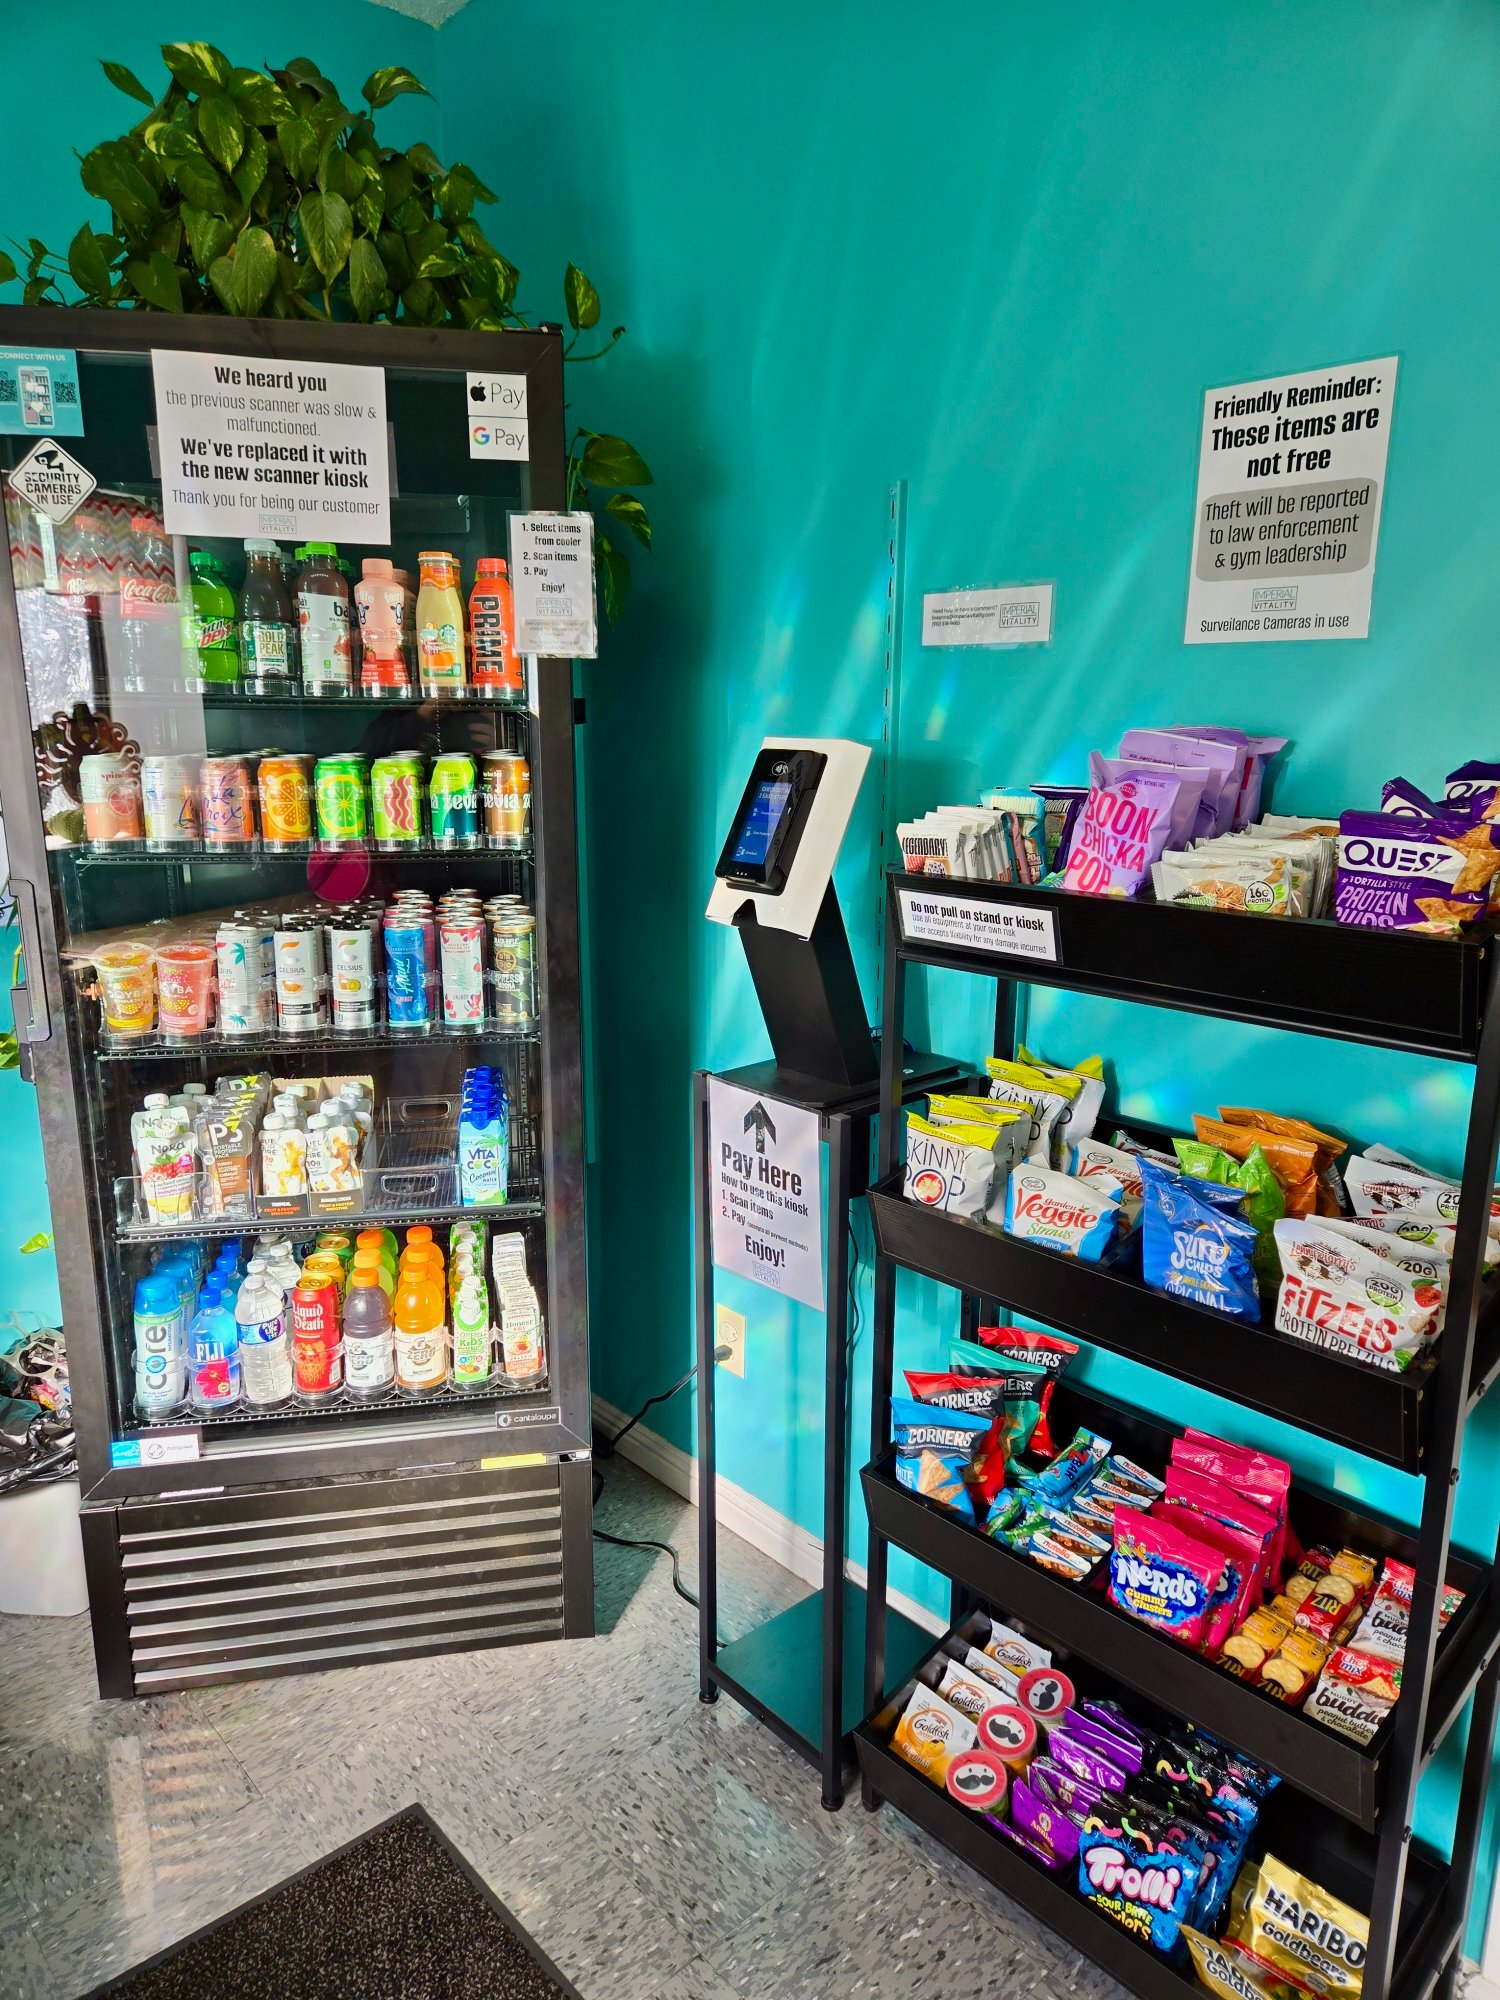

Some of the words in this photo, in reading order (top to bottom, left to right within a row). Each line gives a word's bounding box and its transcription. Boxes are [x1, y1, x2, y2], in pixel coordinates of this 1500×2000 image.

[215, 367, 241, 384] We
[246, 368, 293, 388] heard
[298, 376, 327, 392] you
[166, 390, 186, 405] the
[191, 392, 245, 410] previous
[250, 399, 300, 414] scanner
[304, 403, 329, 416] was
[334, 402, 363, 417] slow
[368, 407, 377, 418] &
[491, 382, 524, 409] Pay
[1214, 390, 1282, 420] Friendly
[1287, 376, 1382, 409] Reminder:
[227, 417, 320, 436] malfunctioned.
[1212, 424, 1269, 450] These
[1274, 413, 1336, 442] items
[1342, 407, 1379, 432] are
[473, 427, 489, 446] G
[495, 429, 525, 450] Pay
[181, 438, 232, 457] We've
[238, 442, 307, 462] replaced
[313, 445, 324, 463] it
[329, 447, 367, 465] with
[1247, 452, 1281, 478] not
[1287, 448, 1331, 473] free
[25, 472, 80, 484] SECURITY
[182, 461, 209, 479] the
[214, 465, 249, 480] new
[254, 469, 319, 485] scanner
[324, 469, 368, 488] kiosk
[26, 484, 82, 495] CAMERAS
[37, 494, 48, 504] IN
[52, 495, 74, 505] USE
[172, 489, 209, 504] Thank
[213, 494, 235, 507] you
[240, 493, 256, 507] for
[261, 494, 294, 512] being
[298, 500, 318, 511] our
[323, 500, 380, 514] customer
[1206, 501, 1241, 520] Theft
[1246, 496, 1272, 517] will
[1277, 494, 1295, 514] be
[1300, 486, 1369, 513] reported
[531, 523, 556, 532] Select
[558, 523, 581, 533] items
[1210, 527, 1223, 544] to
[1228, 524, 1253, 543] law
[1259, 513, 1359, 541] enforcement
[535, 536, 554, 546] from
[556, 537, 581, 546] cooler
[523, 552, 531, 560] 2.
[533, 552, 552, 560] Scan
[555, 552, 577, 561] items
[1214, 553, 1225, 568] &
[1230, 550, 1260, 570] gym
[1266, 540, 1347, 564] leadership
[524, 567, 531, 575] 3.
[534, 567, 548, 577] Pay
[542, 583, 565, 593] Enjoy!
[1254, 588, 1295, 600] IMPERIAL
[1002, 605, 1036, 616] IMPERIAL
[1254, 601, 1295, 610] VITALITY
[1002, 618, 1036, 626] VITALITY
[1263, 614, 1311, 630] Cameras
[1315, 614, 1324, 628] in
[1328, 615, 1349, 627] use
[472, 595, 504, 673] PRIME
[260, 643, 284, 655] PEAK
[1081, 822, 1145, 872] CHICKA
[1344, 839, 1453, 872] QUEST
[1066, 848, 1112, 894] POP
[1350, 876, 1387, 888] TORTILLA
[1389, 881, 1412, 890] STYLE
[1336, 886, 1408, 916] PROTEIN
[911, 900, 922, 913] Do
[924, 902, 939, 915] not
[941, 906, 957, 918] pull
[960, 911, 971, 920] on
[973, 911, 1000, 925] stand
[1003, 917, 1014, 926] or
[1016, 915, 1044, 932] kiosk
[933, 917, 964, 929] equipment
[973, 924, 986, 934] your
[988, 926, 1001, 934] own
[1004, 928, 1016, 937] risk
[928, 928, 949, 938] accepts
[995, 938, 1019, 950] damage
[1021, 943, 1046, 954] incurred
[468, 1148, 495, 1160] VITA
[722, 1142, 753, 1180] Pay
[758, 1156, 802, 1196] Here
[721, 1172, 738, 1187] How
[740, 1178, 748, 1193] to
[750, 1185, 764, 1199] use
[766, 1188, 782, 1207] this
[784, 1195, 809, 1217] kiosk
[722, 1189, 728, 1201] 1.
[730, 1193, 748, 1209] Scan
[750, 1199, 774, 1220] items
[1043, 1198, 1076, 1211] garden
[722, 1206, 730, 1218] 2.
[732, 1209, 746, 1225] Pay
[1015, 1188, 1098, 1229] Veggie
[1027, 1222, 1073, 1239] Straws
[745, 1234, 786, 1267] Enjoy!
[1042, 1241, 1062, 1250] Ranch
[1186, 1258, 1222, 1278] CHIPS
[1403, 1262, 1432, 1276] 20G
[1369, 1285, 1397, 1301] PROTEIN
[1371, 1280, 1399, 1294] 20G
[292, 1300, 323, 1320] Liquid
[294, 1315, 324, 1331] Death
[1280, 1306, 1328, 1348] PROTEIN
[145, 1326, 167, 1390] core
[196, 1342, 224, 1362] FIJI
[513, 1412, 557, 1423] cantaloupe
[895, 1428, 975, 1447] POPCORNERS
[1123, 1462, 1148, 1480] nutella
[1102, 1481, 1130, 1498] nutella
[1063, 1519, 1092, 1538] nutella
[1042, 1539, 1070, 1559] nutella
[1118, 1558, 1197, 1607] Nerds
[1126, 1587, 1168, 1608] Gummy
[1310, 1593, 1342, 1616] RITZ
[1132, 1598, 1173, 1618] Clusters
[1373, 1630, 1402, 1643] peanut
[997, 1648, 1032, 1667] Goldfish
[1341, 1662, 1363, 1674] mix
[950, 1692, 985, 1712] Goldfish
[1316, 1687, 1386, 1726] buddi
[914, 1718, 949, 1739] Goldfish
[1317, 1708, 1348, 1722] peanut
[1349, 1720, 1375, 1736] butter
[1328, 1718, 1369, 1739] chocolate
[1085, 1847, 1181, 1909] Trolli
[1096, 1894, 1122, 1911] SOUR
[1125, 1902, 1152, 1925] BRITE
[1264, 1886, 1367, 1969] HARIBO
[1262, 1921, 1348, 1984] Goldbears
